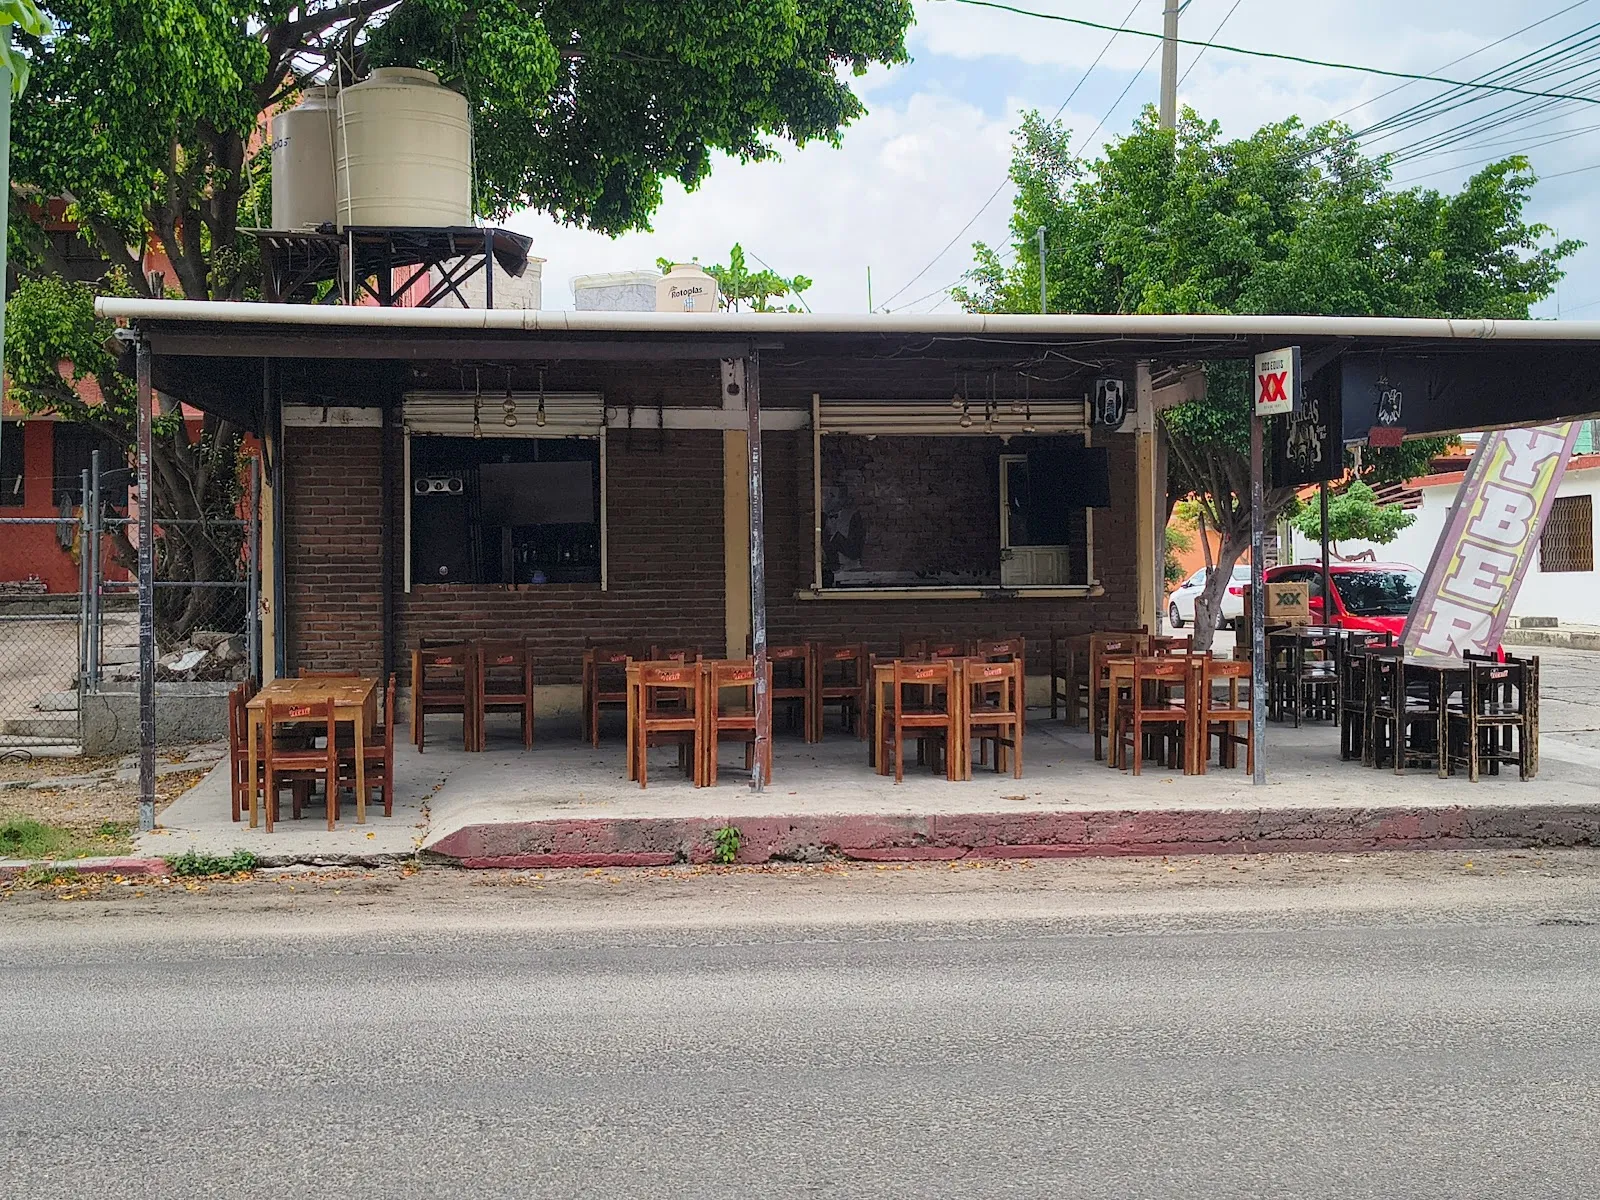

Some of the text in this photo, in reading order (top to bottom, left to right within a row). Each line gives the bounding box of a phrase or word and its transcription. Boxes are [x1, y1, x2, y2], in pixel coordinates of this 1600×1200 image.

[671, 286, 703, 299] Rotoplas
[1258, 371, 1287, 403] XX
[1416, 423, 1567, 657] YBER
[1275, 592, 1302, 606] XX
